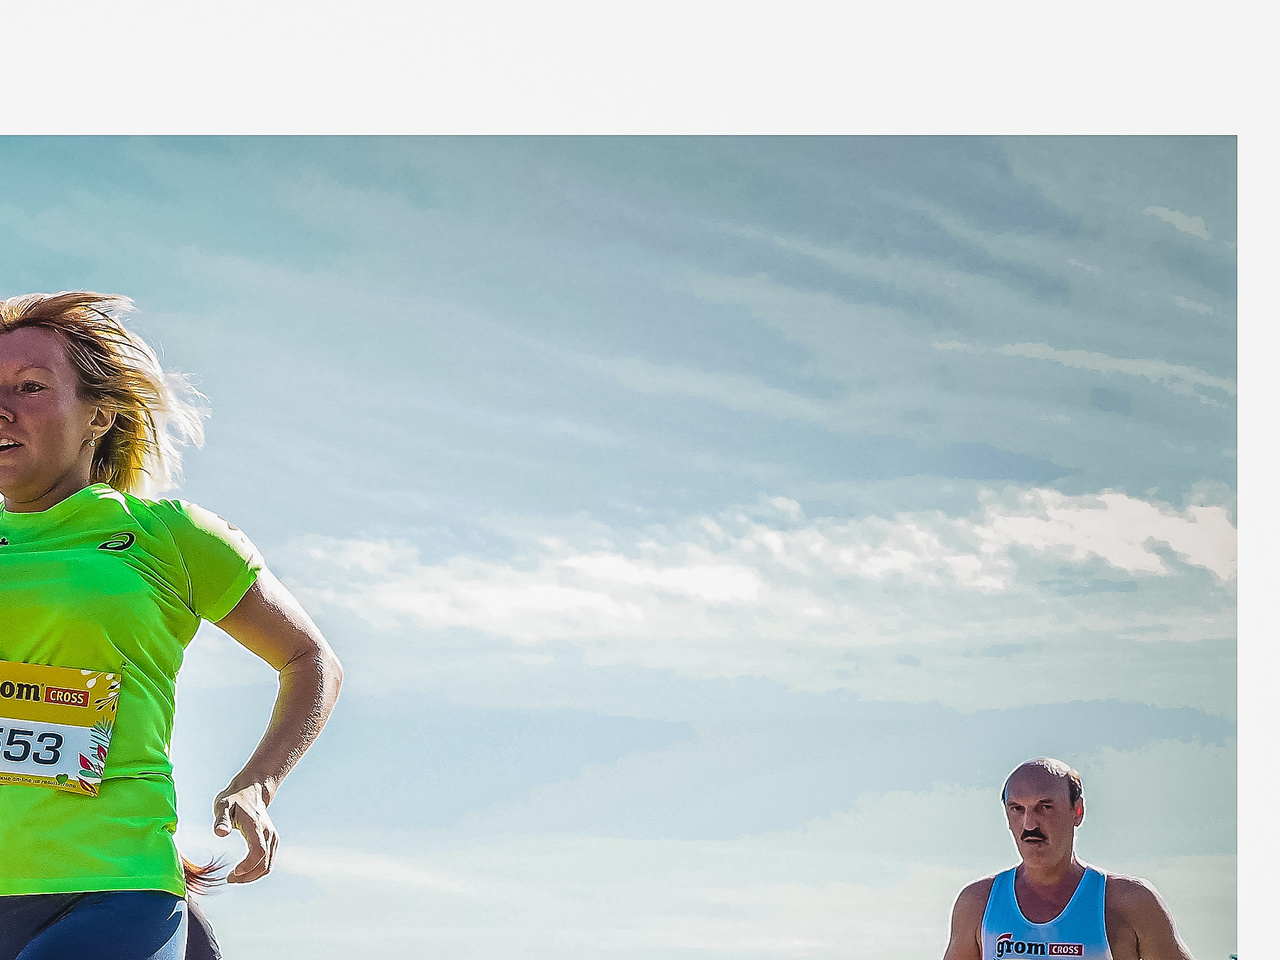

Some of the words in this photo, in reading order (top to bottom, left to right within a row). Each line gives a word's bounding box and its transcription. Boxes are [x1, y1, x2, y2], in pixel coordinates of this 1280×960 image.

[49, 690, 85, 704] CROSS
[996, 938, 1047, 957] grom
[1051, 945, 1079, 955] CROSS
